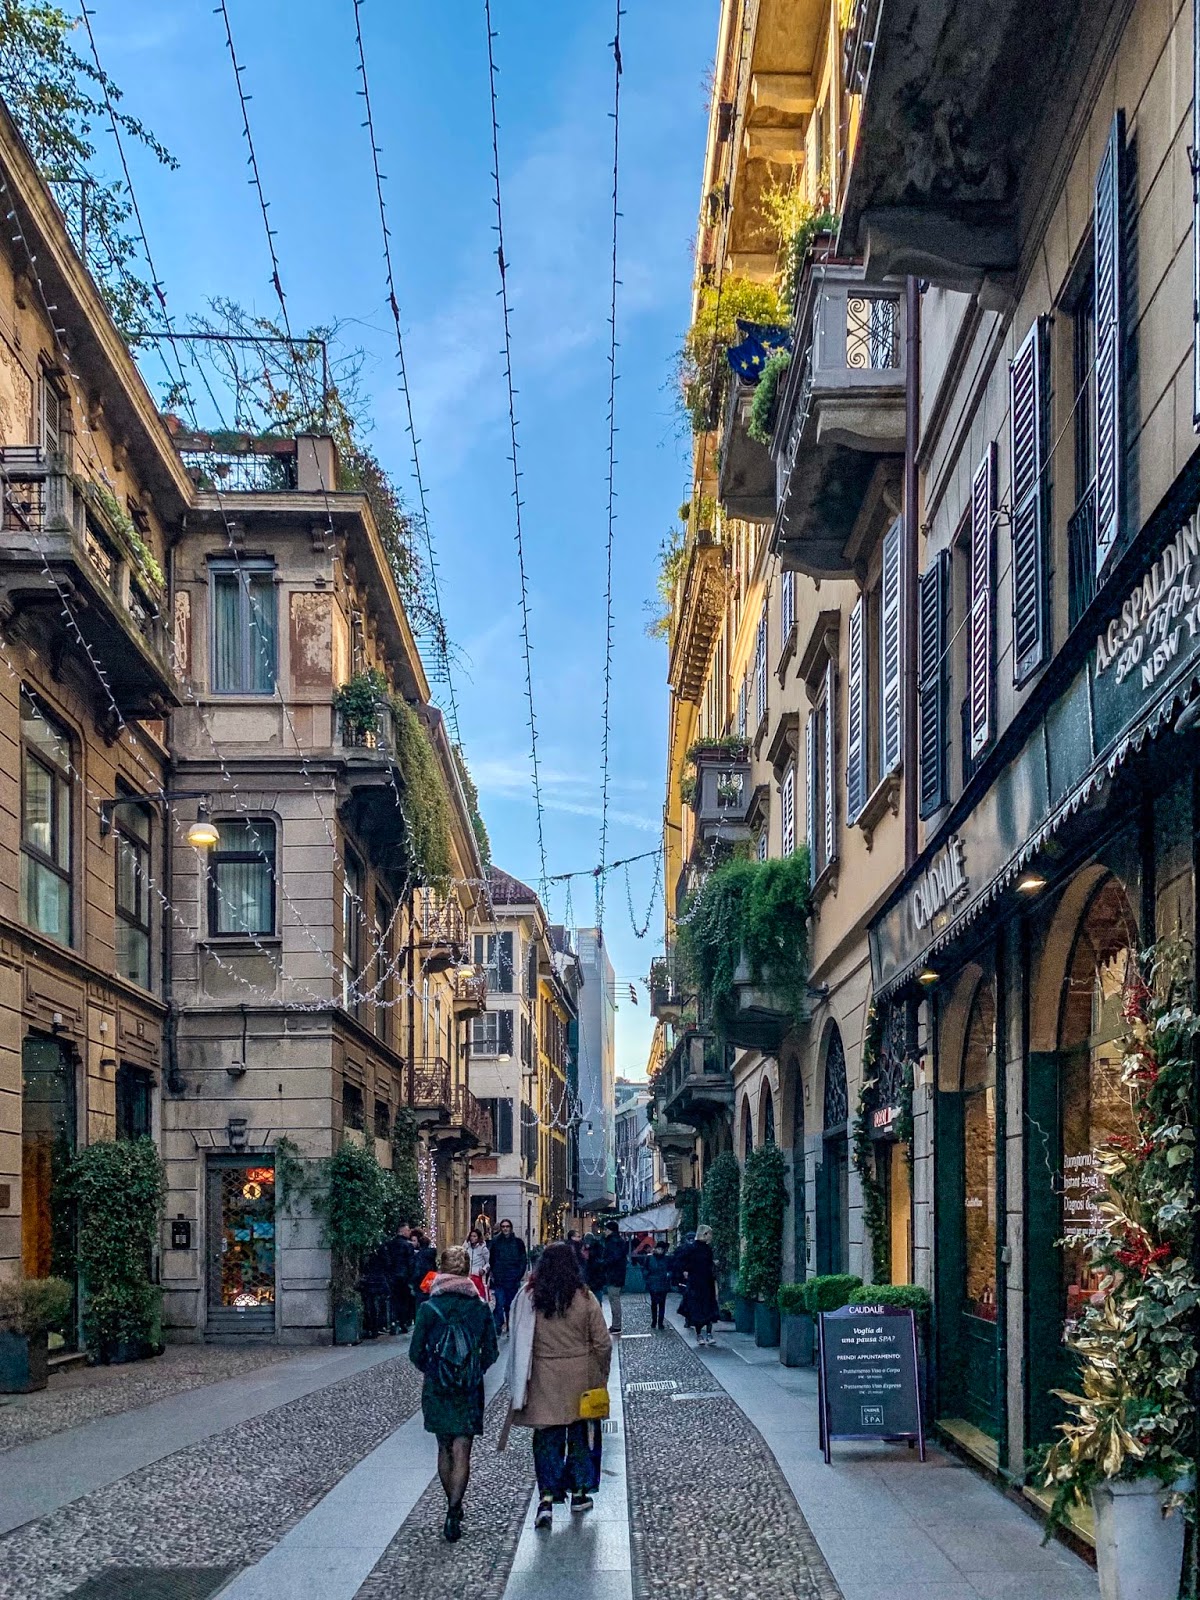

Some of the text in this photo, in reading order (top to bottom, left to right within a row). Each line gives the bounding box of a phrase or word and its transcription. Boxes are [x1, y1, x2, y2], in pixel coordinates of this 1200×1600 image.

[1115, 563, 1195, 684] 520 Fifth
[1142, 598, 1200, 690] NEW Y
[1064, 1174, 1081, 1188] Instant
[853, 1327, 874, 1336] Voglia
[856, 1337, 877, 1345] pausa
[878, 1335, 896, 1343] SPA?
[864, 1416, 881, 1424] SPA
